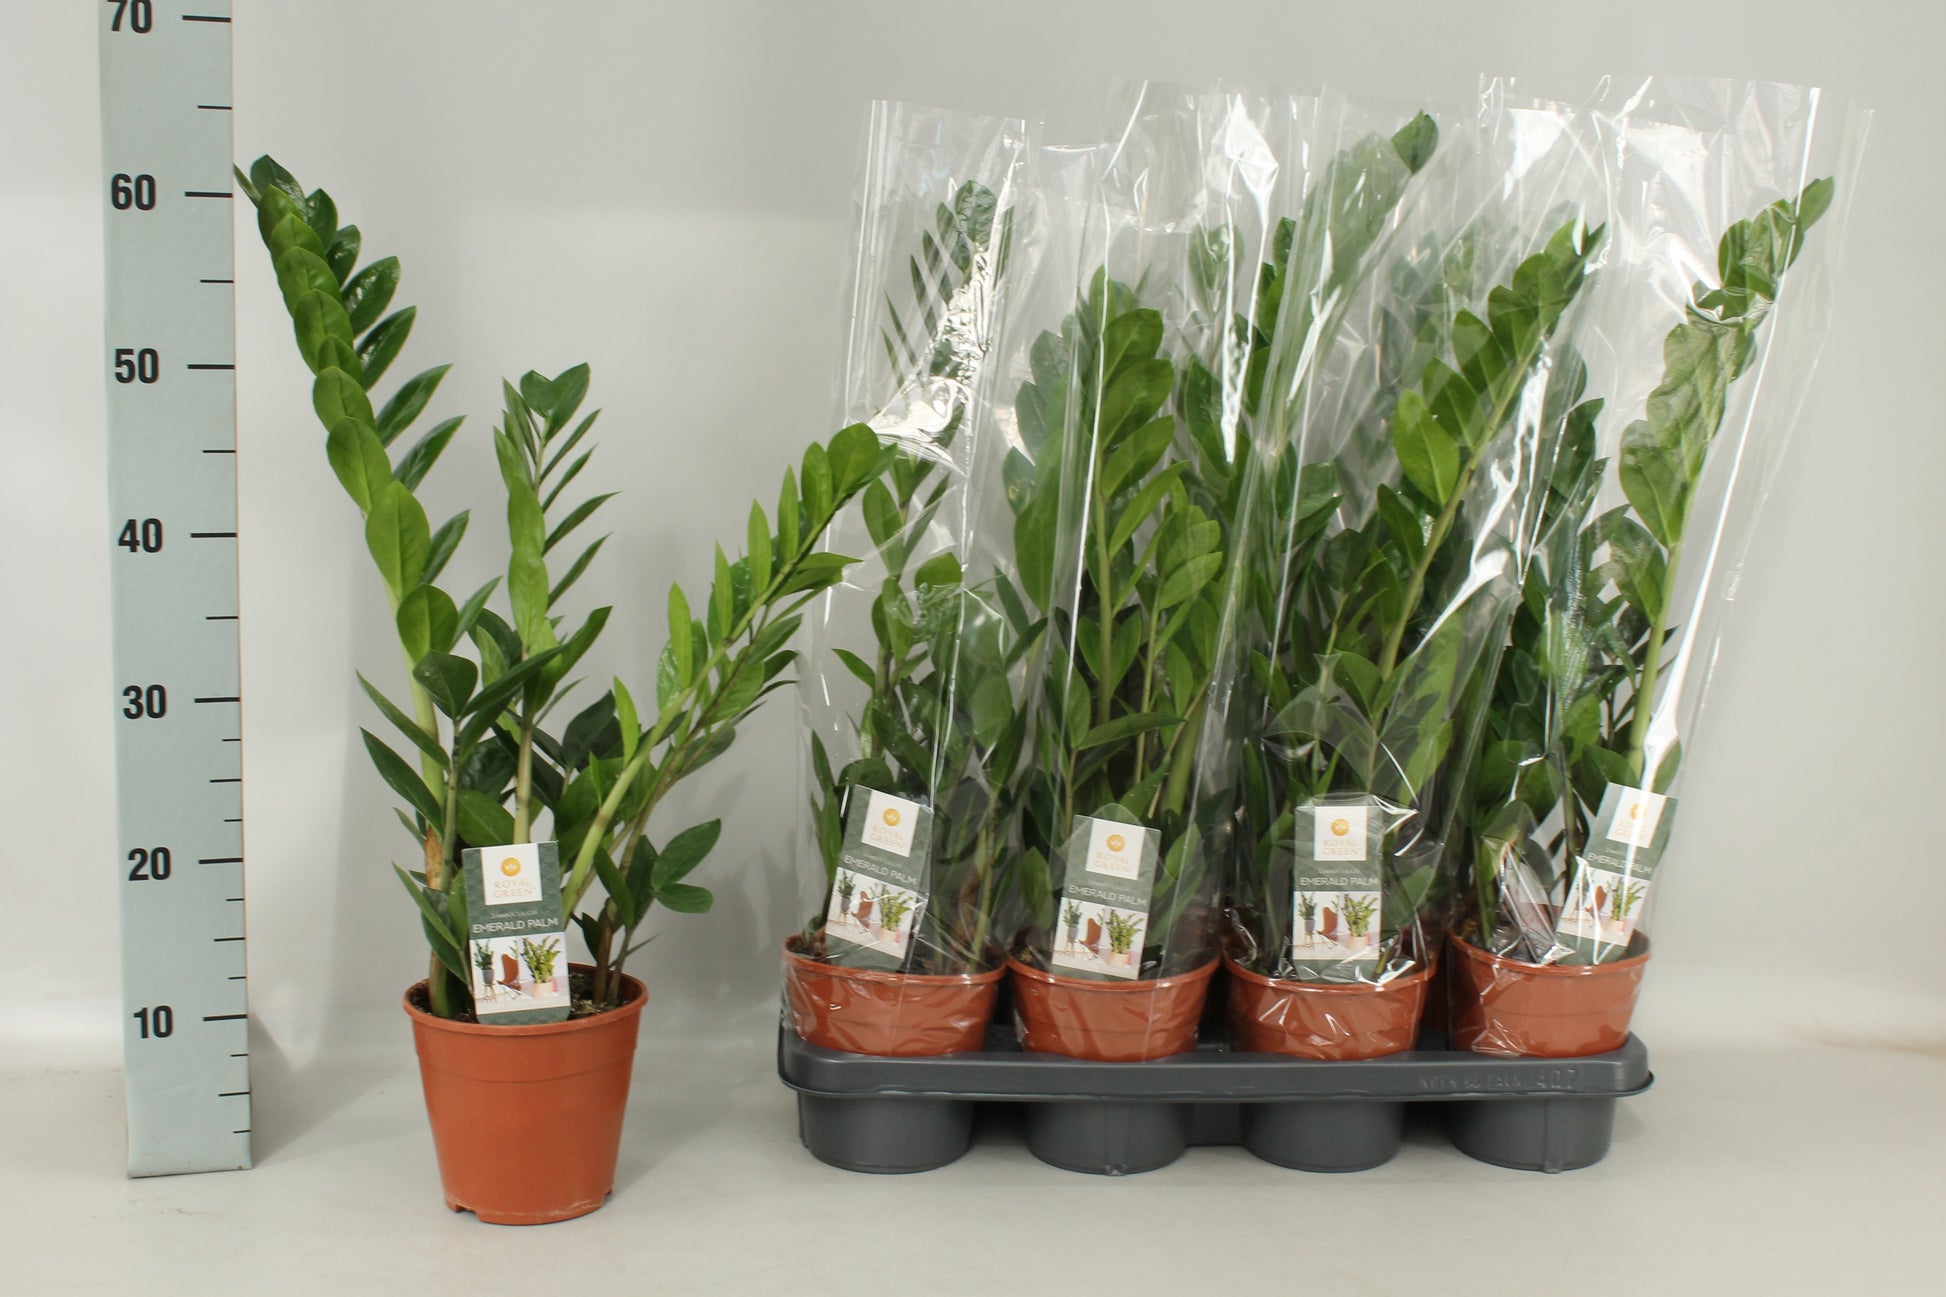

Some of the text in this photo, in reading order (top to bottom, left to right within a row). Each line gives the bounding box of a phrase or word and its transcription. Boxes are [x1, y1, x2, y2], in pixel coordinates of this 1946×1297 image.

[107, 0, 152, 33] 70
[112, 174, 155, 210] 60
[115, 348, 158, 383] 50
[119, 518, 162, 553] 40
[123, 685, 166, 719] 30
[128, 847, 171, 881] 20
[843, 854, 888, 876] EMERALD
[493, 888, 535, 898] GREEN
[1067, 884, 1117, 901] EMERALD
[1299, 877, 1349, 886] EMERALD
[472, 917, 559, 934] EMERALD PALM
[134, 1006, 172, 1038] 10
